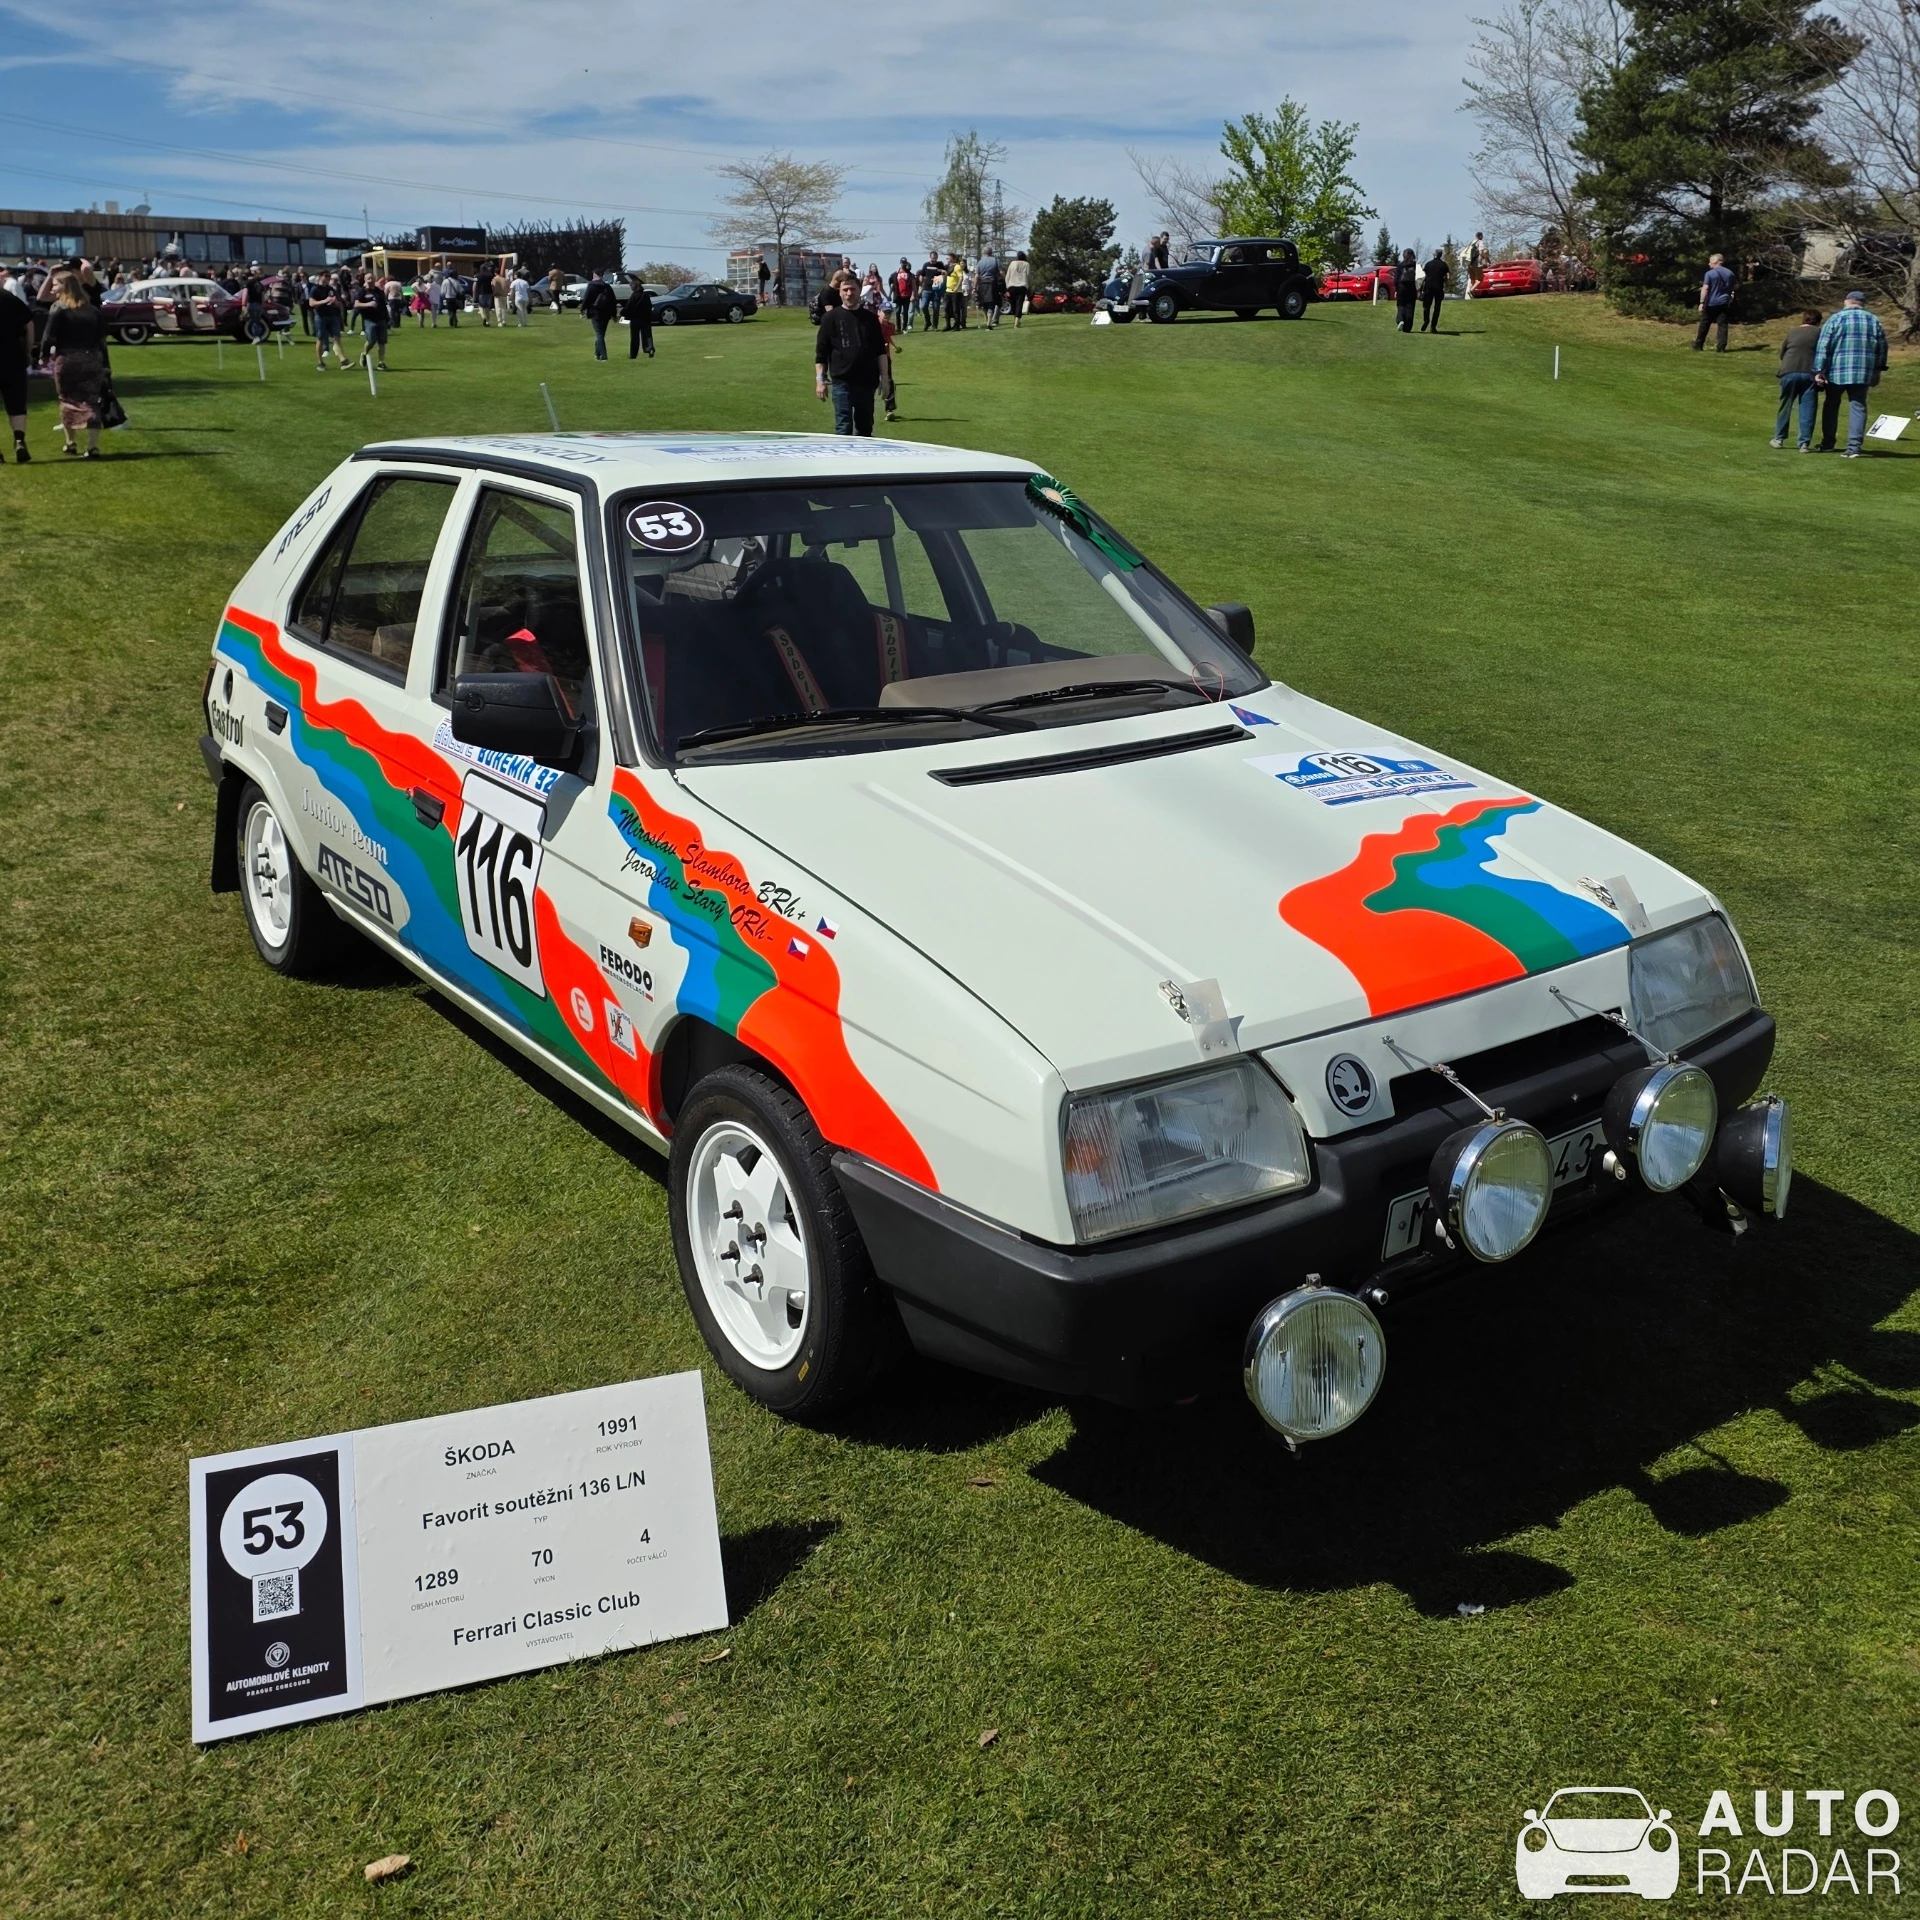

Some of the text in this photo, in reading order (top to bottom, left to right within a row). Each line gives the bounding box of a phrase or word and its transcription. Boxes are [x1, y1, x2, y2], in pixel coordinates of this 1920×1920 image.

[273, 485, 333, 565] ATESO
[635, 511, 693, 541] 53
[882, 612, 899, 684] Sabelt
[779, 633, 817, 707] Sabelt
[211, 699, 245, 748] Castrol
[1317, 755, 1382, 775] 116
[302, 786, 389, 866] Junior team
[618, 808, 677, 856] Miroslav
[317, 841, 394, 925] ATESO
[620, 847, 679, 892] Jaroslav
[457, 811, 534, 969] 116
[599, 943, 653, 992] FERODO
[574, 991, 590, 1026] E
[597, 1415, 638, 1437] 1991
[444, 1439, 516, 1468] ŠKODA
[596, 1438, 643, 1454] ROK VÝROBY
[466, 1468, 497, 1480] ZNAČKA
[422, 1469, 646, 1530] Favorit soutěžní 136 L/N
[243, 1500, 305, 1556] 53
[533, 1515, 548, 1525] TYP
[639, 1528, 651, 1545] 4
[531, 1548, 554, 1568] 70
[626, 1549, 668, 1566] POČET VÁLCŮ
[414, 1568, 459, 1592] 1289
[533, 1574, 556, 1586] VÝKON
[410, 1594, 465, 1612] OBSAH MOTORU
[453, 1591, 641, 1646] Ferrari Classic Club
[525, 1632, 574, 1648] VYSTAVOVATEL
[226, 1661, 330, 1693] AUTOMOBILOVÉ KLENOTY
[246, 1679, 311, 1697] PRAGUE CONCOURS
